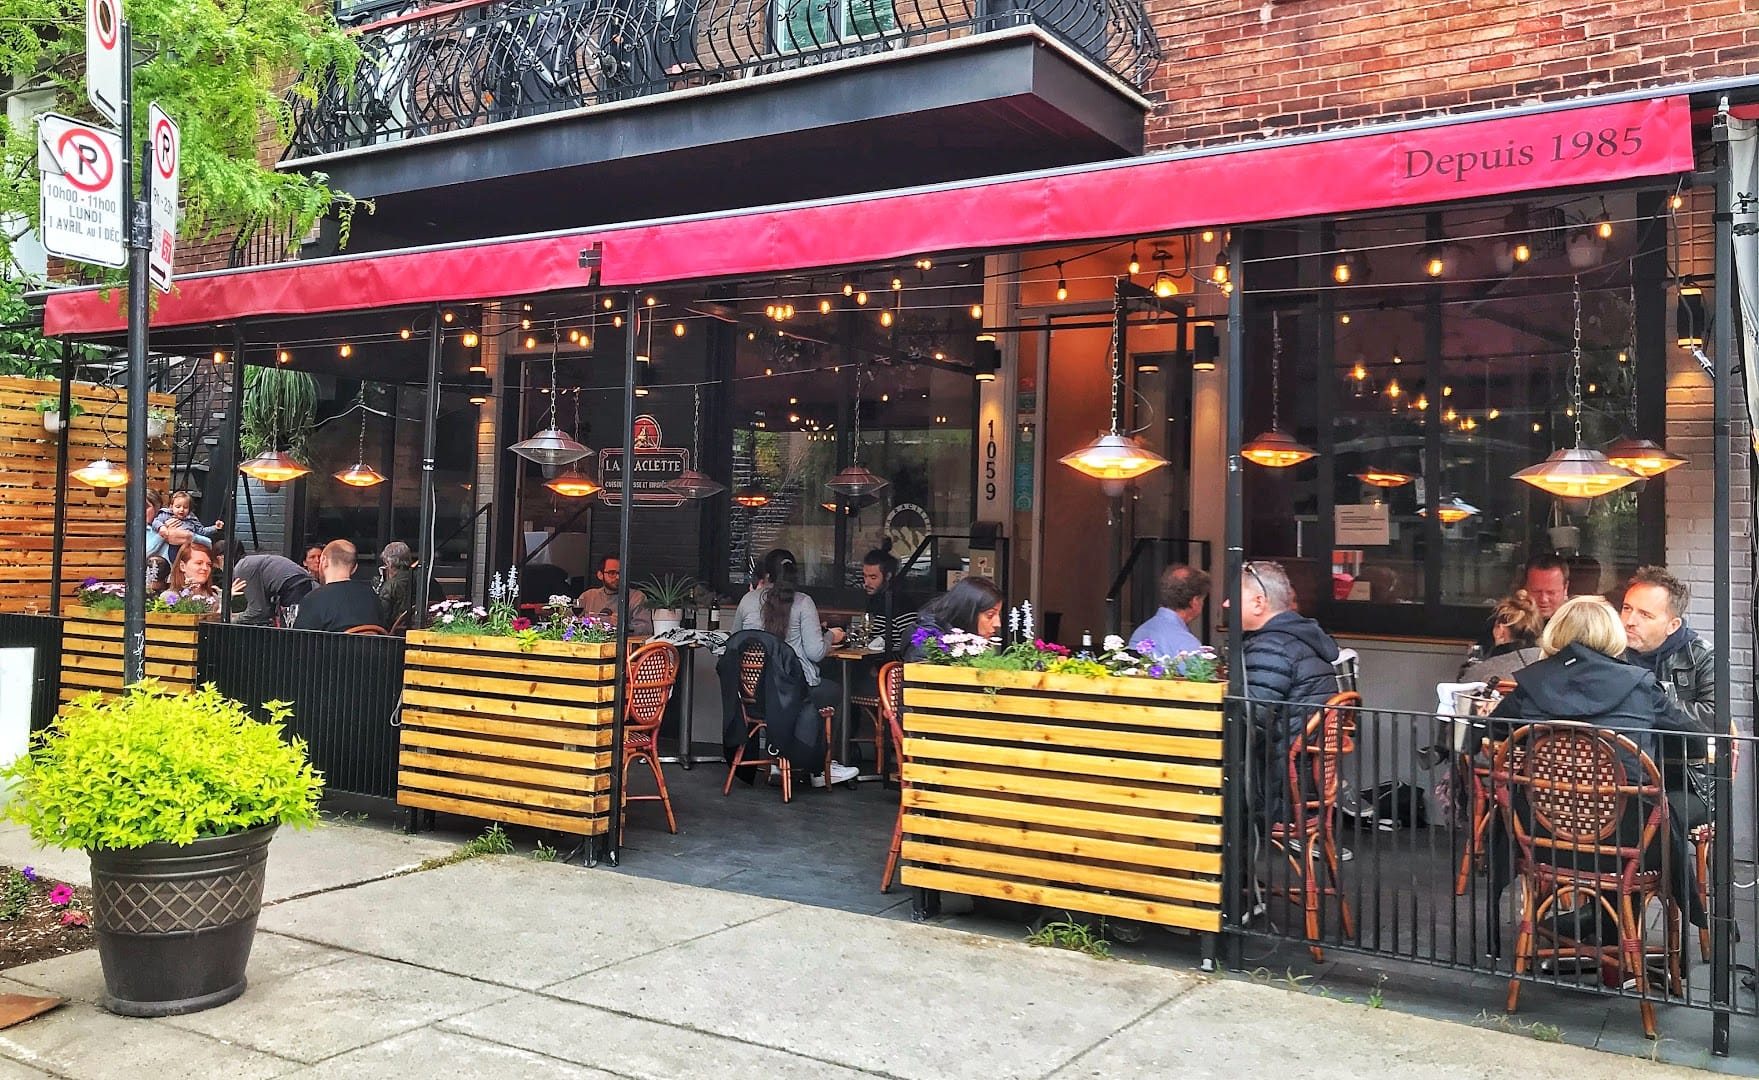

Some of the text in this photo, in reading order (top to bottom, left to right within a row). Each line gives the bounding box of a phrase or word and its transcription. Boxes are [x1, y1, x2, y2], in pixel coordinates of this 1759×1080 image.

[1403, 126, 1643, 182] Depuis 1985
[47, 184, 78, 203] 10h00
[88, 195, 116, 213] 11h00
[69, 205, 102, 224] LUNDI
[56, 217, 83, 234] AVRIL
[87, 226, 96, 238] AU
[104, 227, 120, 243] DÉC
[604, 459, 681, 472] LA ACLETTE
[985, 419, 997, 501] 1059
